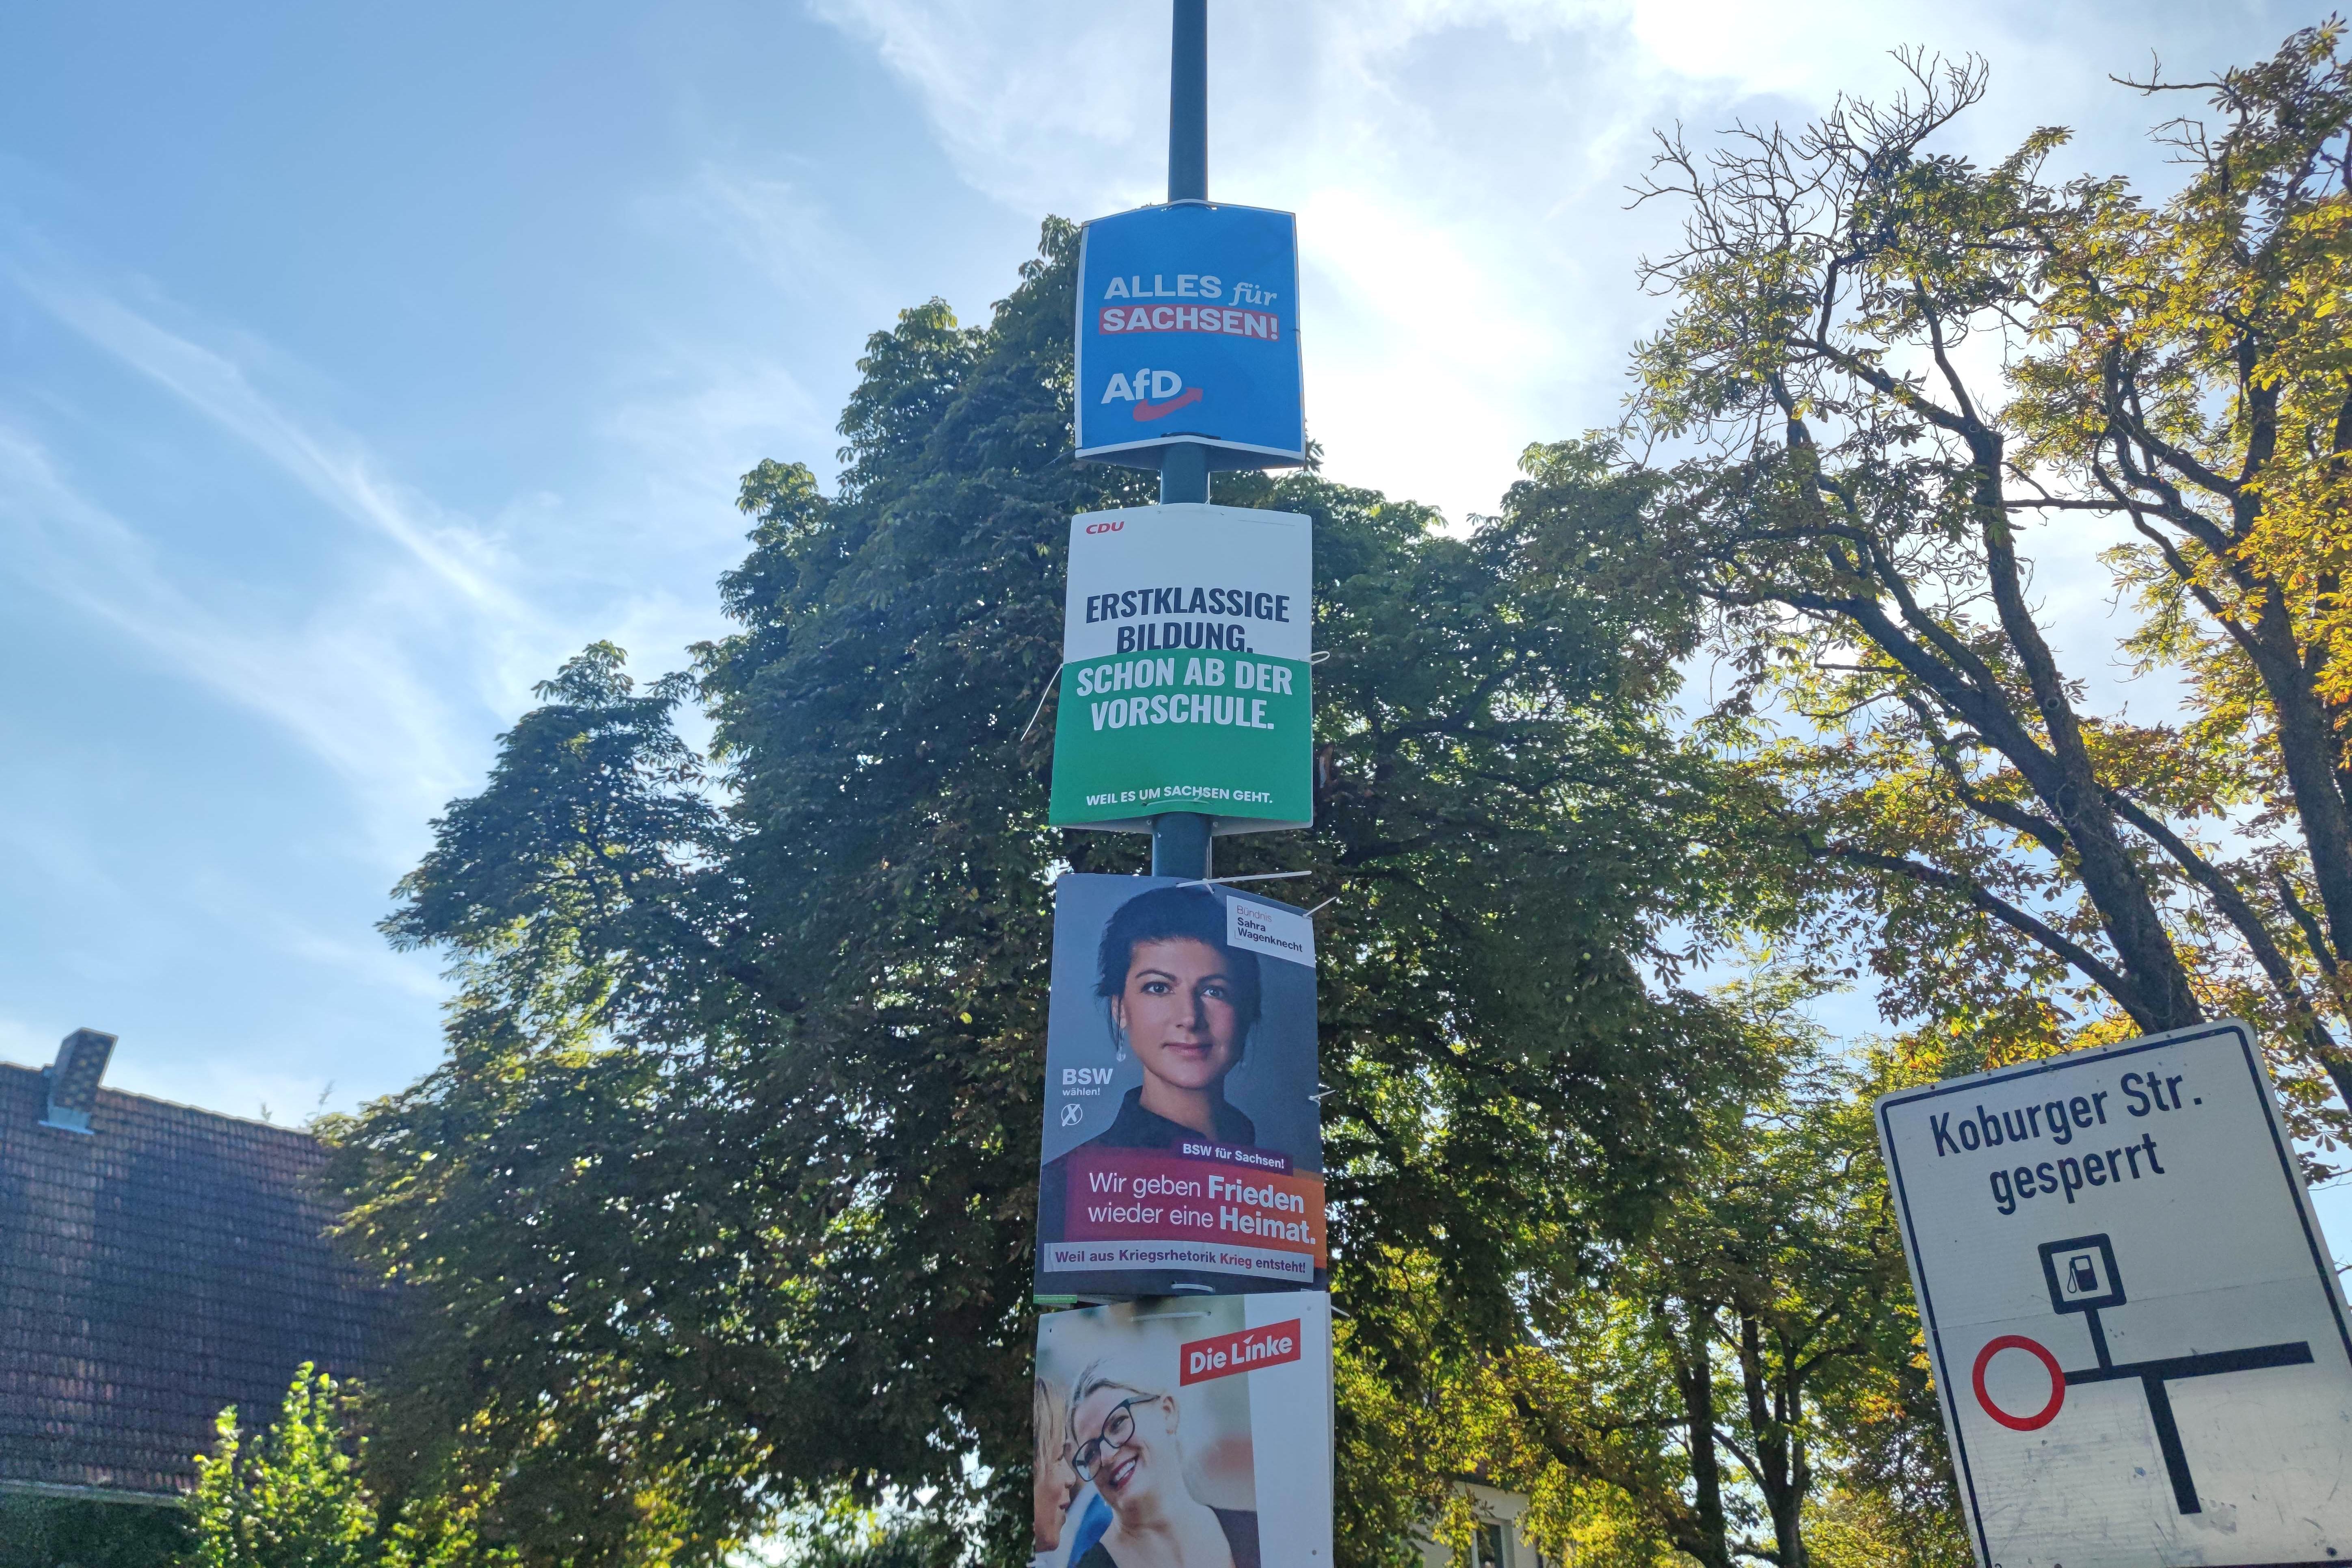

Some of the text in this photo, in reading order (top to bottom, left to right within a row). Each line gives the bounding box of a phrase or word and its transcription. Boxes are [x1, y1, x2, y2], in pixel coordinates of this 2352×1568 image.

[1104, 275, 1278, 306] ALLES für
[1103, 307, 1278, 340] SACHSEN!
[1101, 368, 1182, 404] AfD
[1086, 521, 1125, 534] CDU
[1085, 587, 1290, 623] ERSTKLASSIGE
[1116, 622, 1254, 654] BILDUNG.
[1077, 657, 1293, 697] SCHON AB DER
[1091, 694, 1274, 731] VORSCHULE.
[1086, 786, 1273, 806] WEIL ES UM SACHSEN GEHT.
[1237, 904, 1272, 922] Bündnis
[1237, 917, 1266, 932] Sahra
[1238, 927, 1303, 952] Wagenknecht
[1062, 1068, 1113, 1085] BSW
[1062, 1086, 1100, 1097] wählen!
[1930, 1072, 2203, 1157] Koburger Str.
[1182, 1143, 1284, 1169] BSW für Sachsen!
[1990, 1133, 2165, 1215] gesperrt
[1089, 1172, 1304, 1213] Wir geben Frieden
[1088, 1202, 1316, 1245] wieder eine Heimat.
[1055, 1250, 1306, 1274] Weil aus Kriegsrhetorik Krieg entsteht!
[1190, 1348, 1226, 1375] Die
